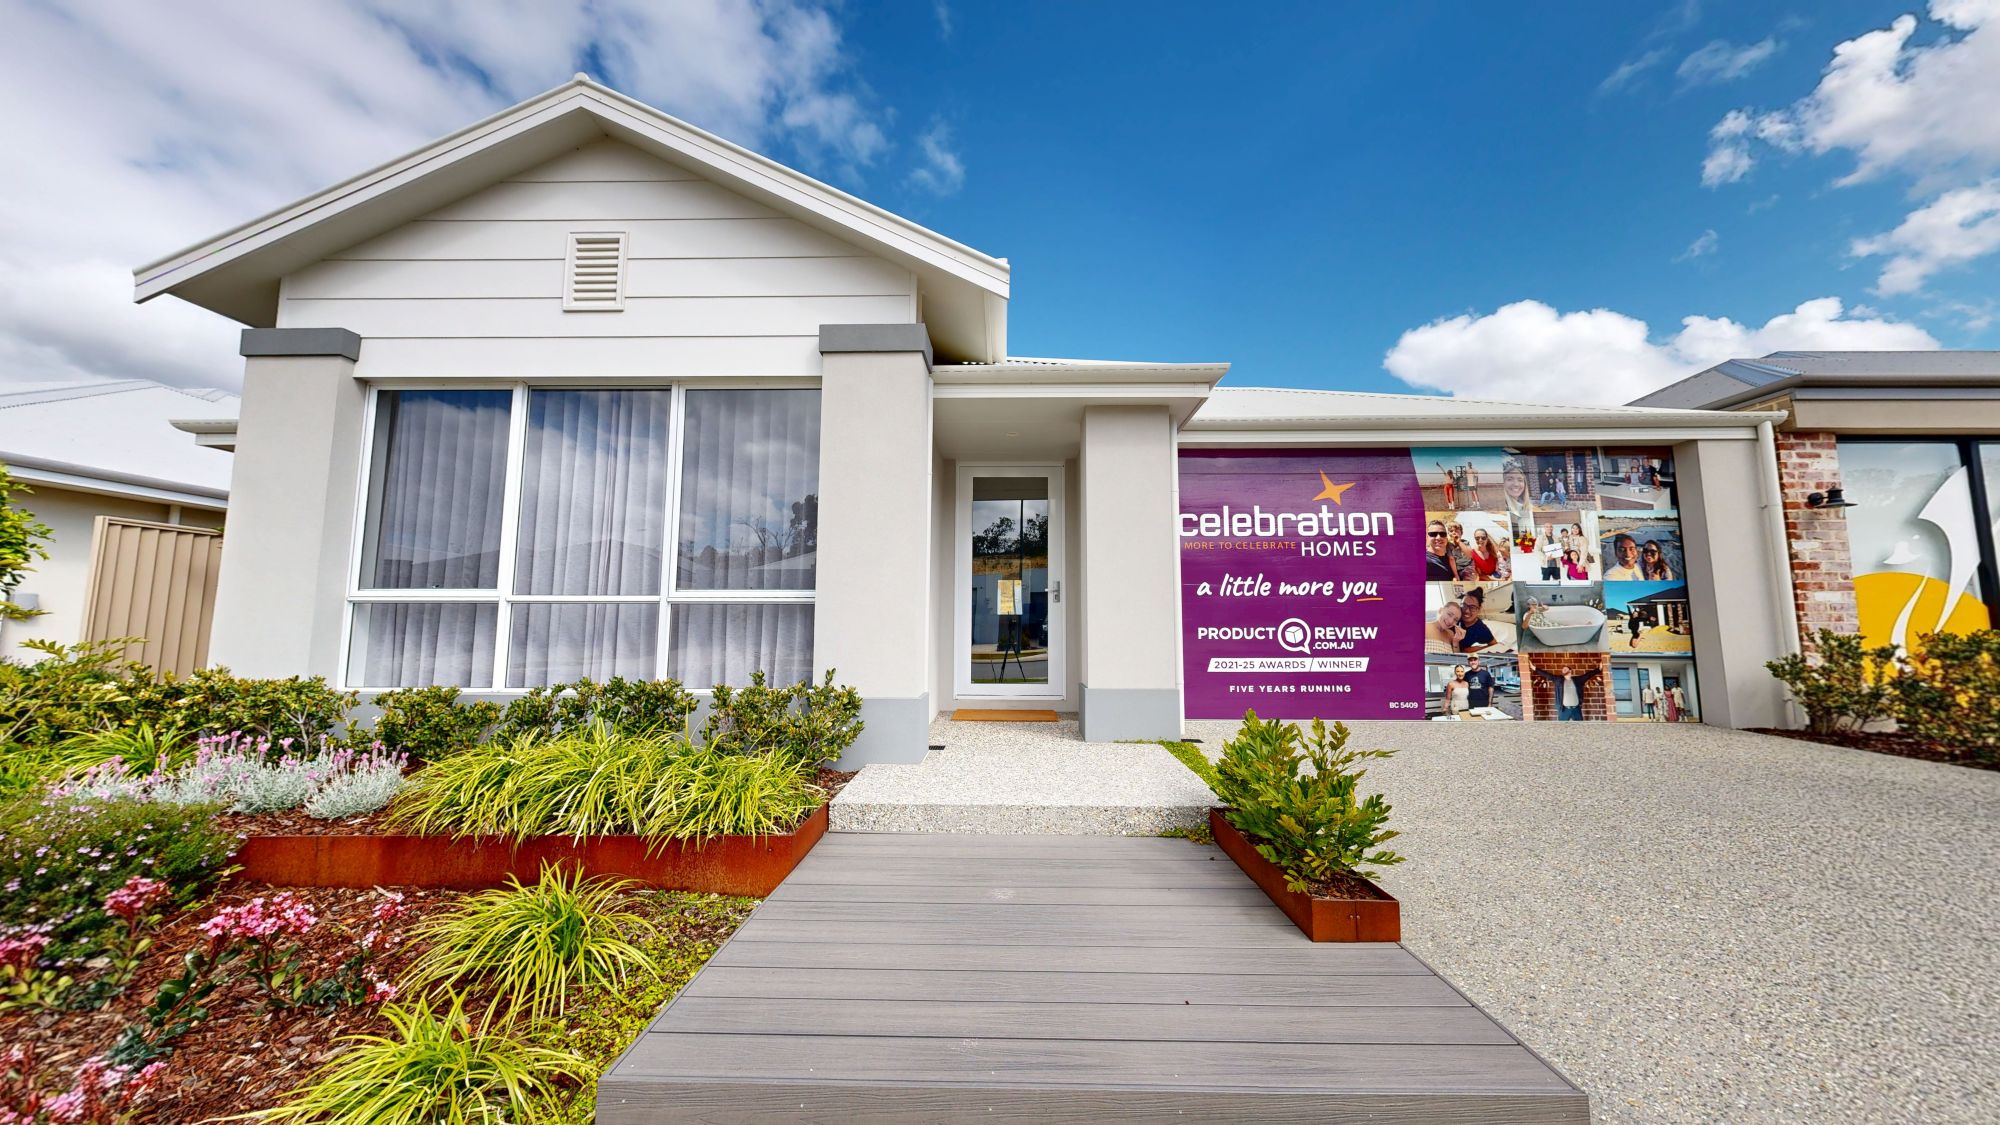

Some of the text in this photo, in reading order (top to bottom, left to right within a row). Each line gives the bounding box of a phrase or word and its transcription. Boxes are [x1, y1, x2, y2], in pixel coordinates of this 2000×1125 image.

[1179, 505, 1394, 537] celebration
[1184, 541, 1297, 550] MORE TO CELEBRATE
[1301, 541, 1377, 557] HOMES
[1196, 573, 1378, 604] a little more you
[1197, 627, 1378, 640] PRODUCT REVIEW
[1312, 642, 1354, 650] .COM.AU
[1214, 660, 1363, 670] 2021-25 AWARDS WINNER
[1229, 685, 1351, 693] FIVE YEARS RUNNING
[1400, 701, 1418, 709] 5409
